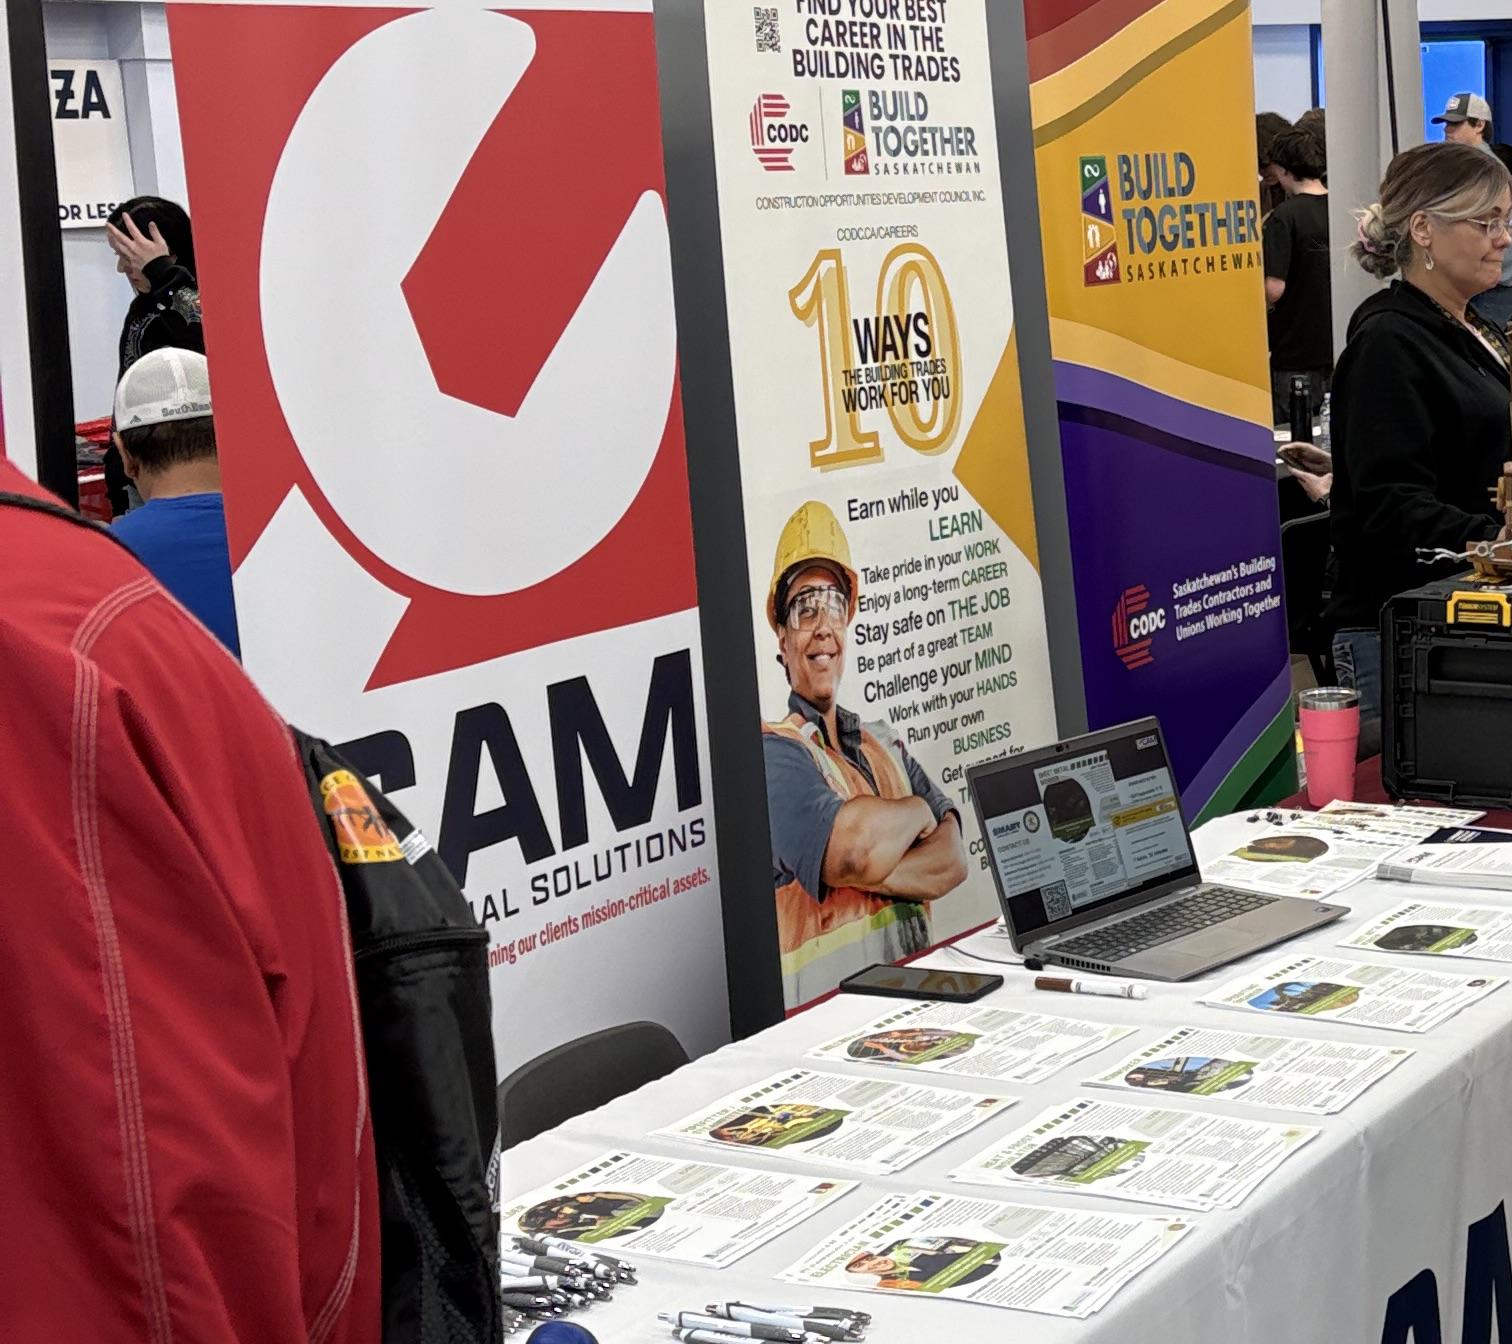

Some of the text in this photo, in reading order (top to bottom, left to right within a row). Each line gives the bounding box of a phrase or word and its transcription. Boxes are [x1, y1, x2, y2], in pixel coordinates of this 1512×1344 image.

[805, 18, 944, 53] CAREER IN THE
[792, 49, 961, 83] BUILDING TRADES
[868, 90, 929, 121] BUILD
[767, 123, 809, 143] CODC
[871, 126, 978, 157] TOGETHER
[873, 162, 981, 175] SASKATCHEWAN
[1117, 152, 1196, 202] BUILD
[87, 203, 124, 220] LES
[756, 196, 819, 210] CONSTRUCTION
[819, 194, 881, 208] OPPORTUNITIES
[882, 191, 938, 205] DEVELOPMENT
[939, 190, 972, 204] COUNCIL
[837, 225, 919, 242] CODC.CA/CAREERS
[1121, 200, 1259, 255] TOGETHER
[852, 311, 932, 364] WAYS
[788, 242, 963, 472] 10
[842, 358, 946, 387] THE BUILDING TRADES
[841, 375, 950, 413] WORK FOR YOU
[847, 484, 959, 522] Earn while you
[928, 509, 983, 542] LEARN
[861, 538, 1001, 586] Take pride in your WORK
[1173, 556, 1276, 599] Saskatchewan's Building
[858, 562, 1008, 615] Enjoy a long-term CAREER
[1174, 574, 1272, 621] Trades Contractors and
[854, 587, 1011, 646] Stay safe on THE JOB
[1130, 608, 1166, 639] CODC
[1176, 594, 1281, 641] Unions Working Together
[857, 621, 993, 674] Be part of a great TEAM
[863, 643, 1013, 703] Challenge your MIND
[888, 670, 1018, 724] Work with your HANDS
[907, 709, 985, 745] Run your own
[952, 722, 1012, 757] BUSINESS
[942, 763, 964, 785] Get
[531, 818, 706, 906] SOLUTIONS
[518, 933, 537, 957] our
[539, 915, 580, 947] clients
[581, 878, 671, 931] mission-critical
[673, 866, 711, 896] assets.
